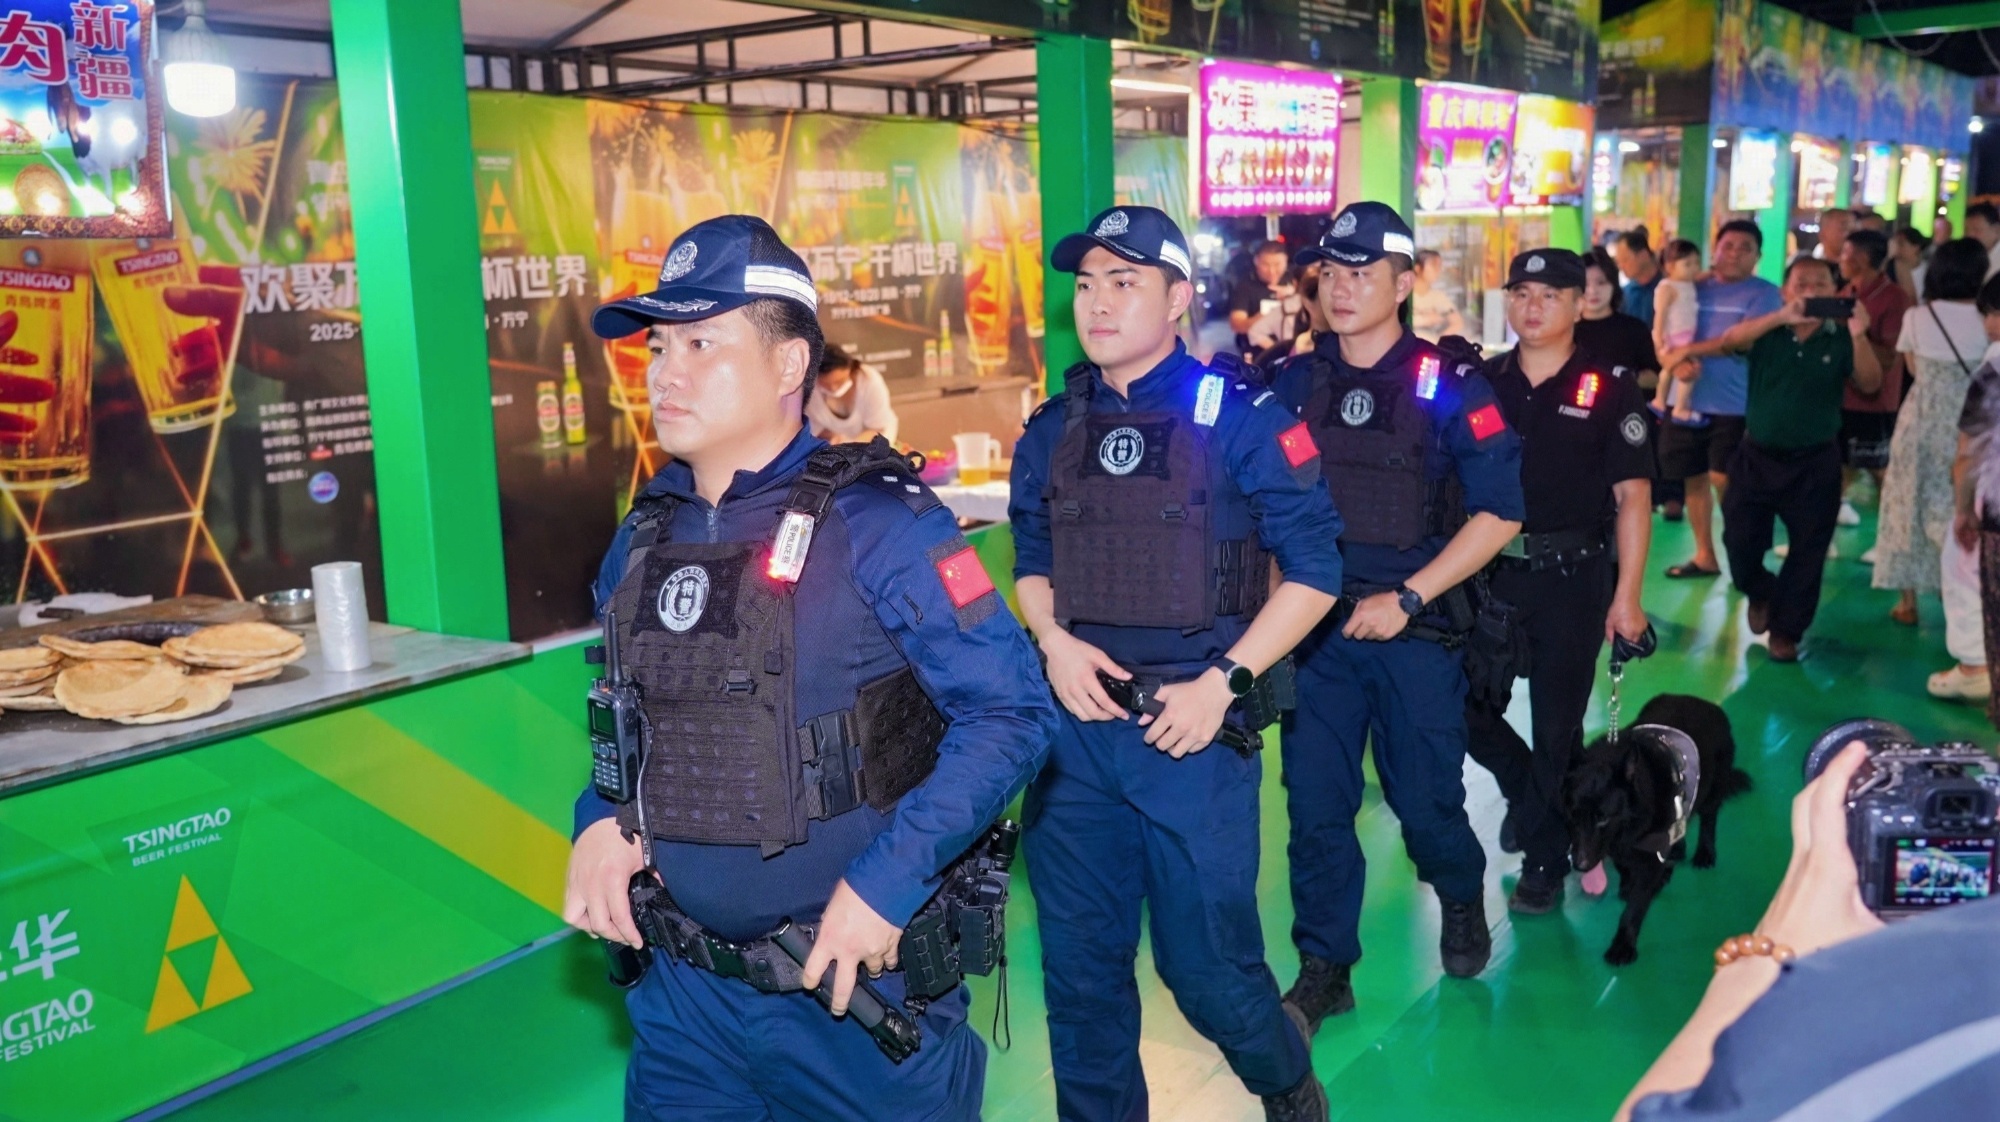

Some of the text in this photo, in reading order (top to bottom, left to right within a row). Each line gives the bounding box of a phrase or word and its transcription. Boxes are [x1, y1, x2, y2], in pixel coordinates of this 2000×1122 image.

[0, 10, 69, 85] 肉
[71, 1, 133, 99] 新疆
[119, 250, 180, 274] TSINGTAO
[481, 254, 588, 301] 杯世界
[803, 245, 863, 281] 万宁
[0, 271, 71, 291] TSINGTAO
[1202, 388, 1213, 413] POLICE
[784, 532, 797, 555] POLICE
[680, 580, 695, 614] 特警
[122, 807, 232, 853] TSINGTAO
[132, 833, 223, 867] BEER FESTIVAL
[0, 908, 81, 981] 华
[0, 988, 94, 1047] GTAO
